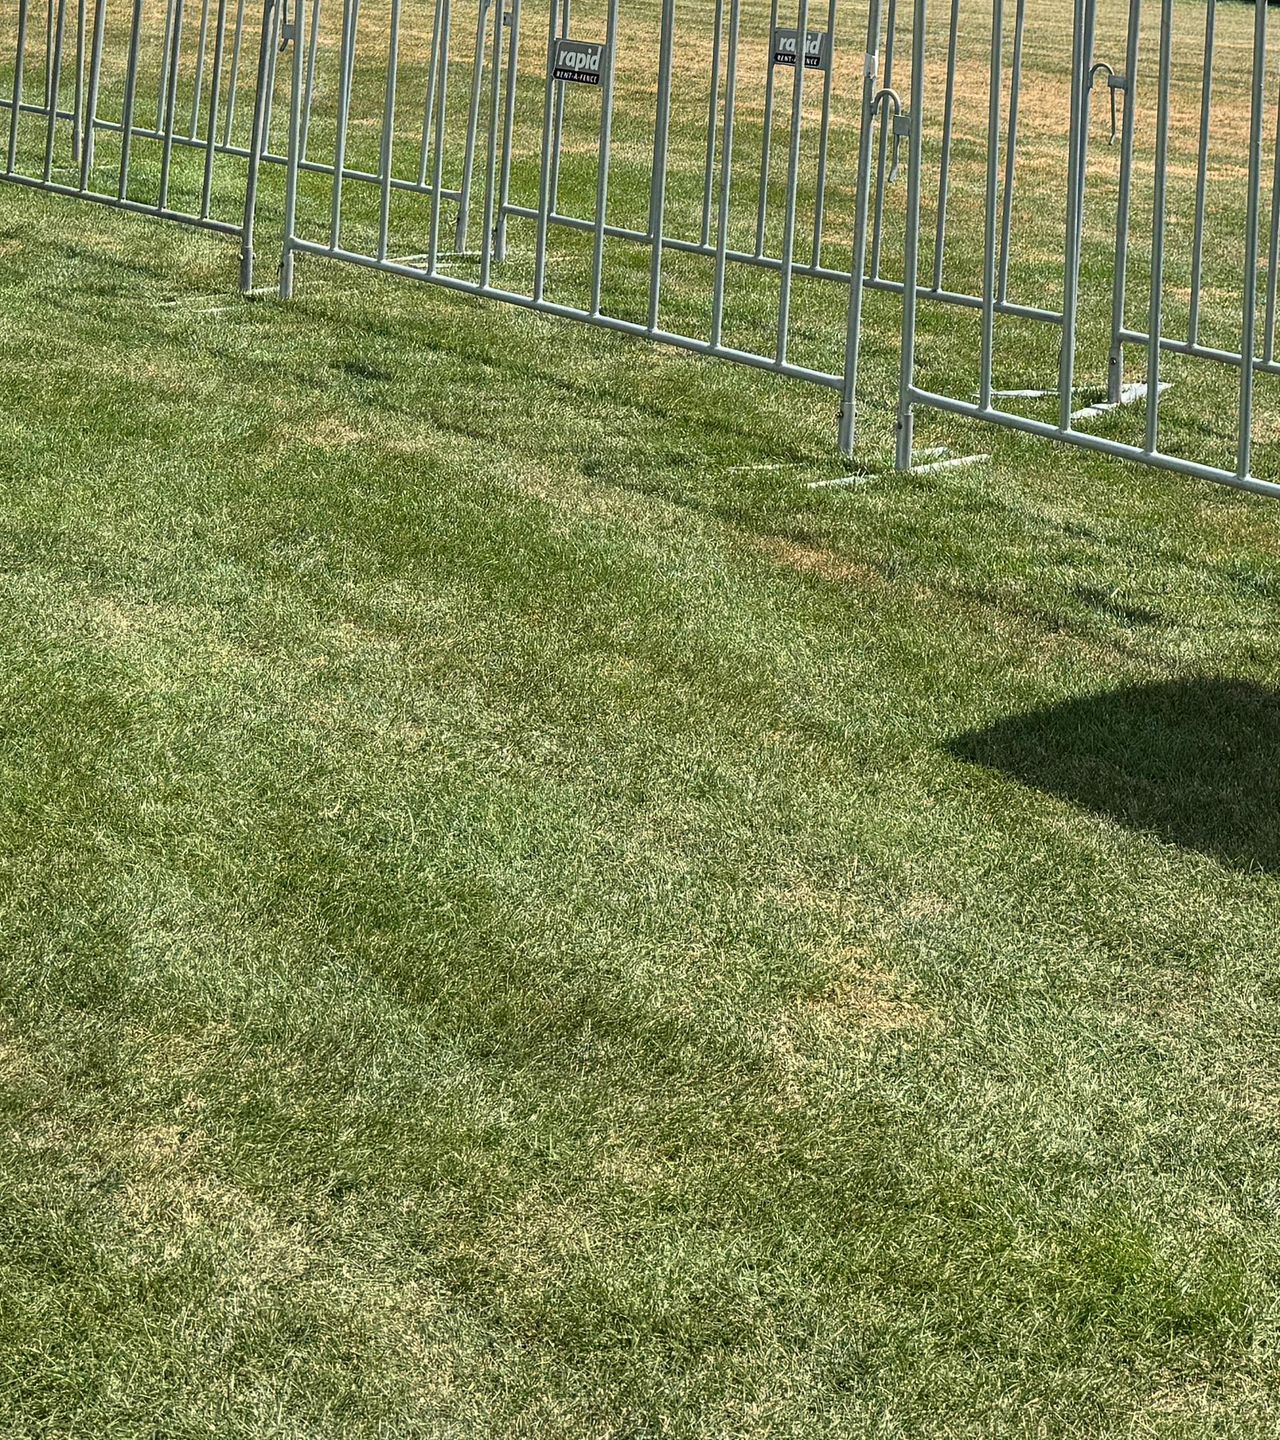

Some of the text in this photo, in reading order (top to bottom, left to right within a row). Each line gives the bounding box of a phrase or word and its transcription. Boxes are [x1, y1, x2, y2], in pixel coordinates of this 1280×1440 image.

[779, 32, 822, 54] raid
[558, 45, 602, 71] rapid
[556, 70, 597, 84] RENT-A-FENCE
